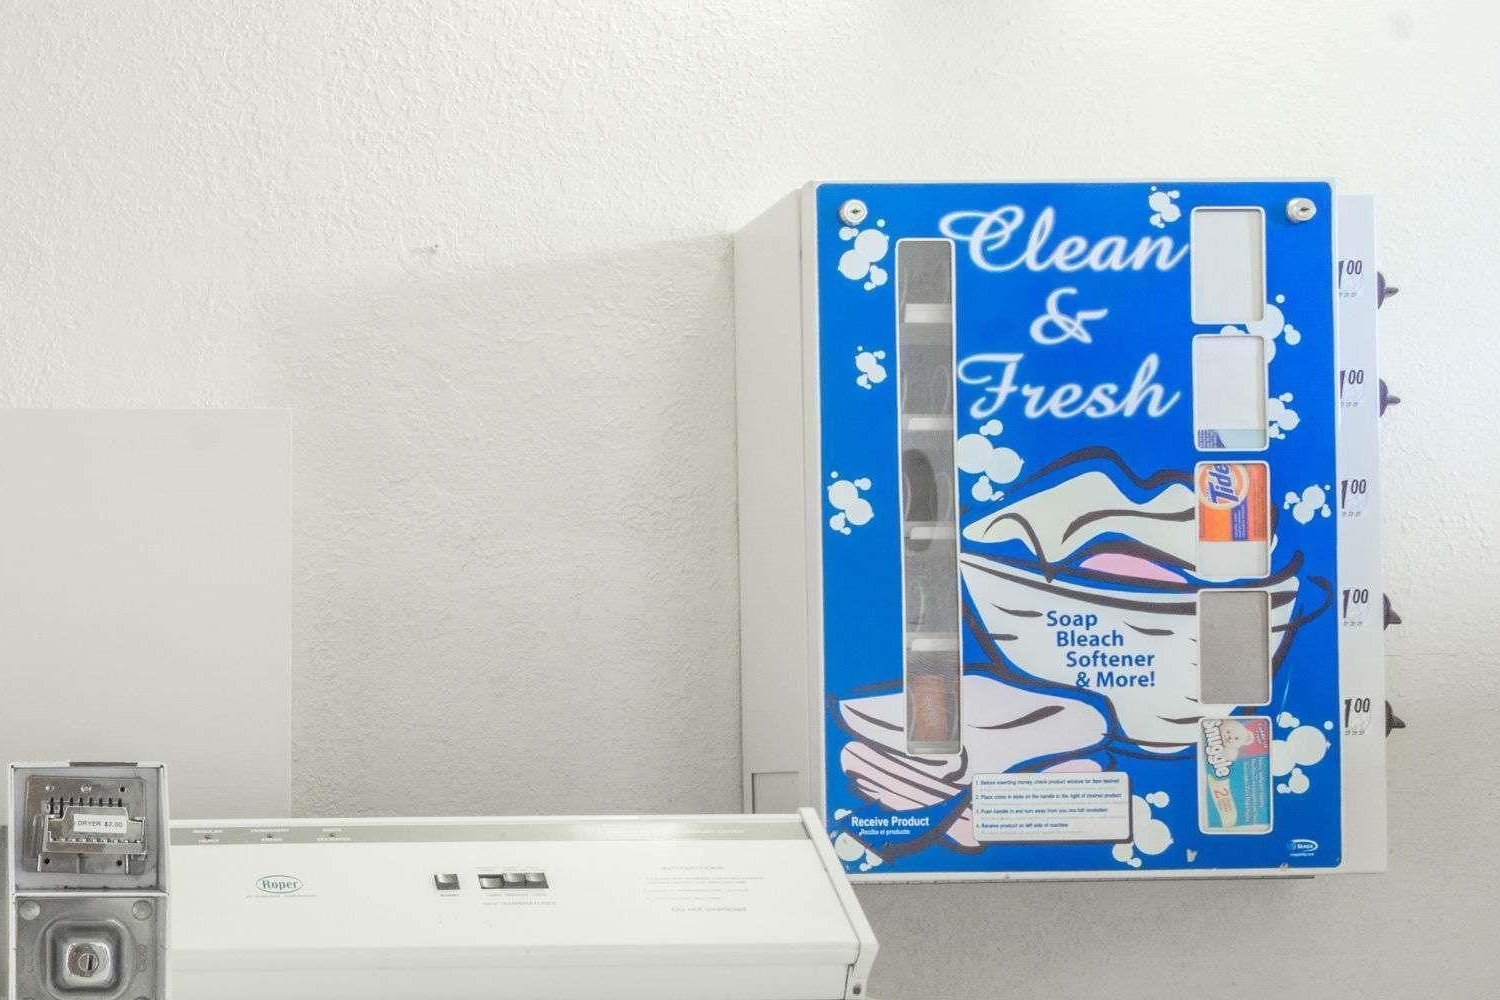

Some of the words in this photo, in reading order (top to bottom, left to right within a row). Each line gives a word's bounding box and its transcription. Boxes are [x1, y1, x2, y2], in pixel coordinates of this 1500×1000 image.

[939, 205, 1189, 272] Clean
[1029, 287, 1109, 345] &
[957, 352, 1181, 420] Fresh
[1208, 463, 1239, 504] Tide
[1047, 610, 1097, 630] Soap
[1057, 630, 1124, 646] Bleach
[1066, 650, 1155, 667] Softener
[1076, 671, 1090, 687] &
[1096, 671, 1155, 687] More!
[851, 816, 889, 827] Receive
[891, 816, 930, 826] Product
[262, 879, 298, 890] Roper
